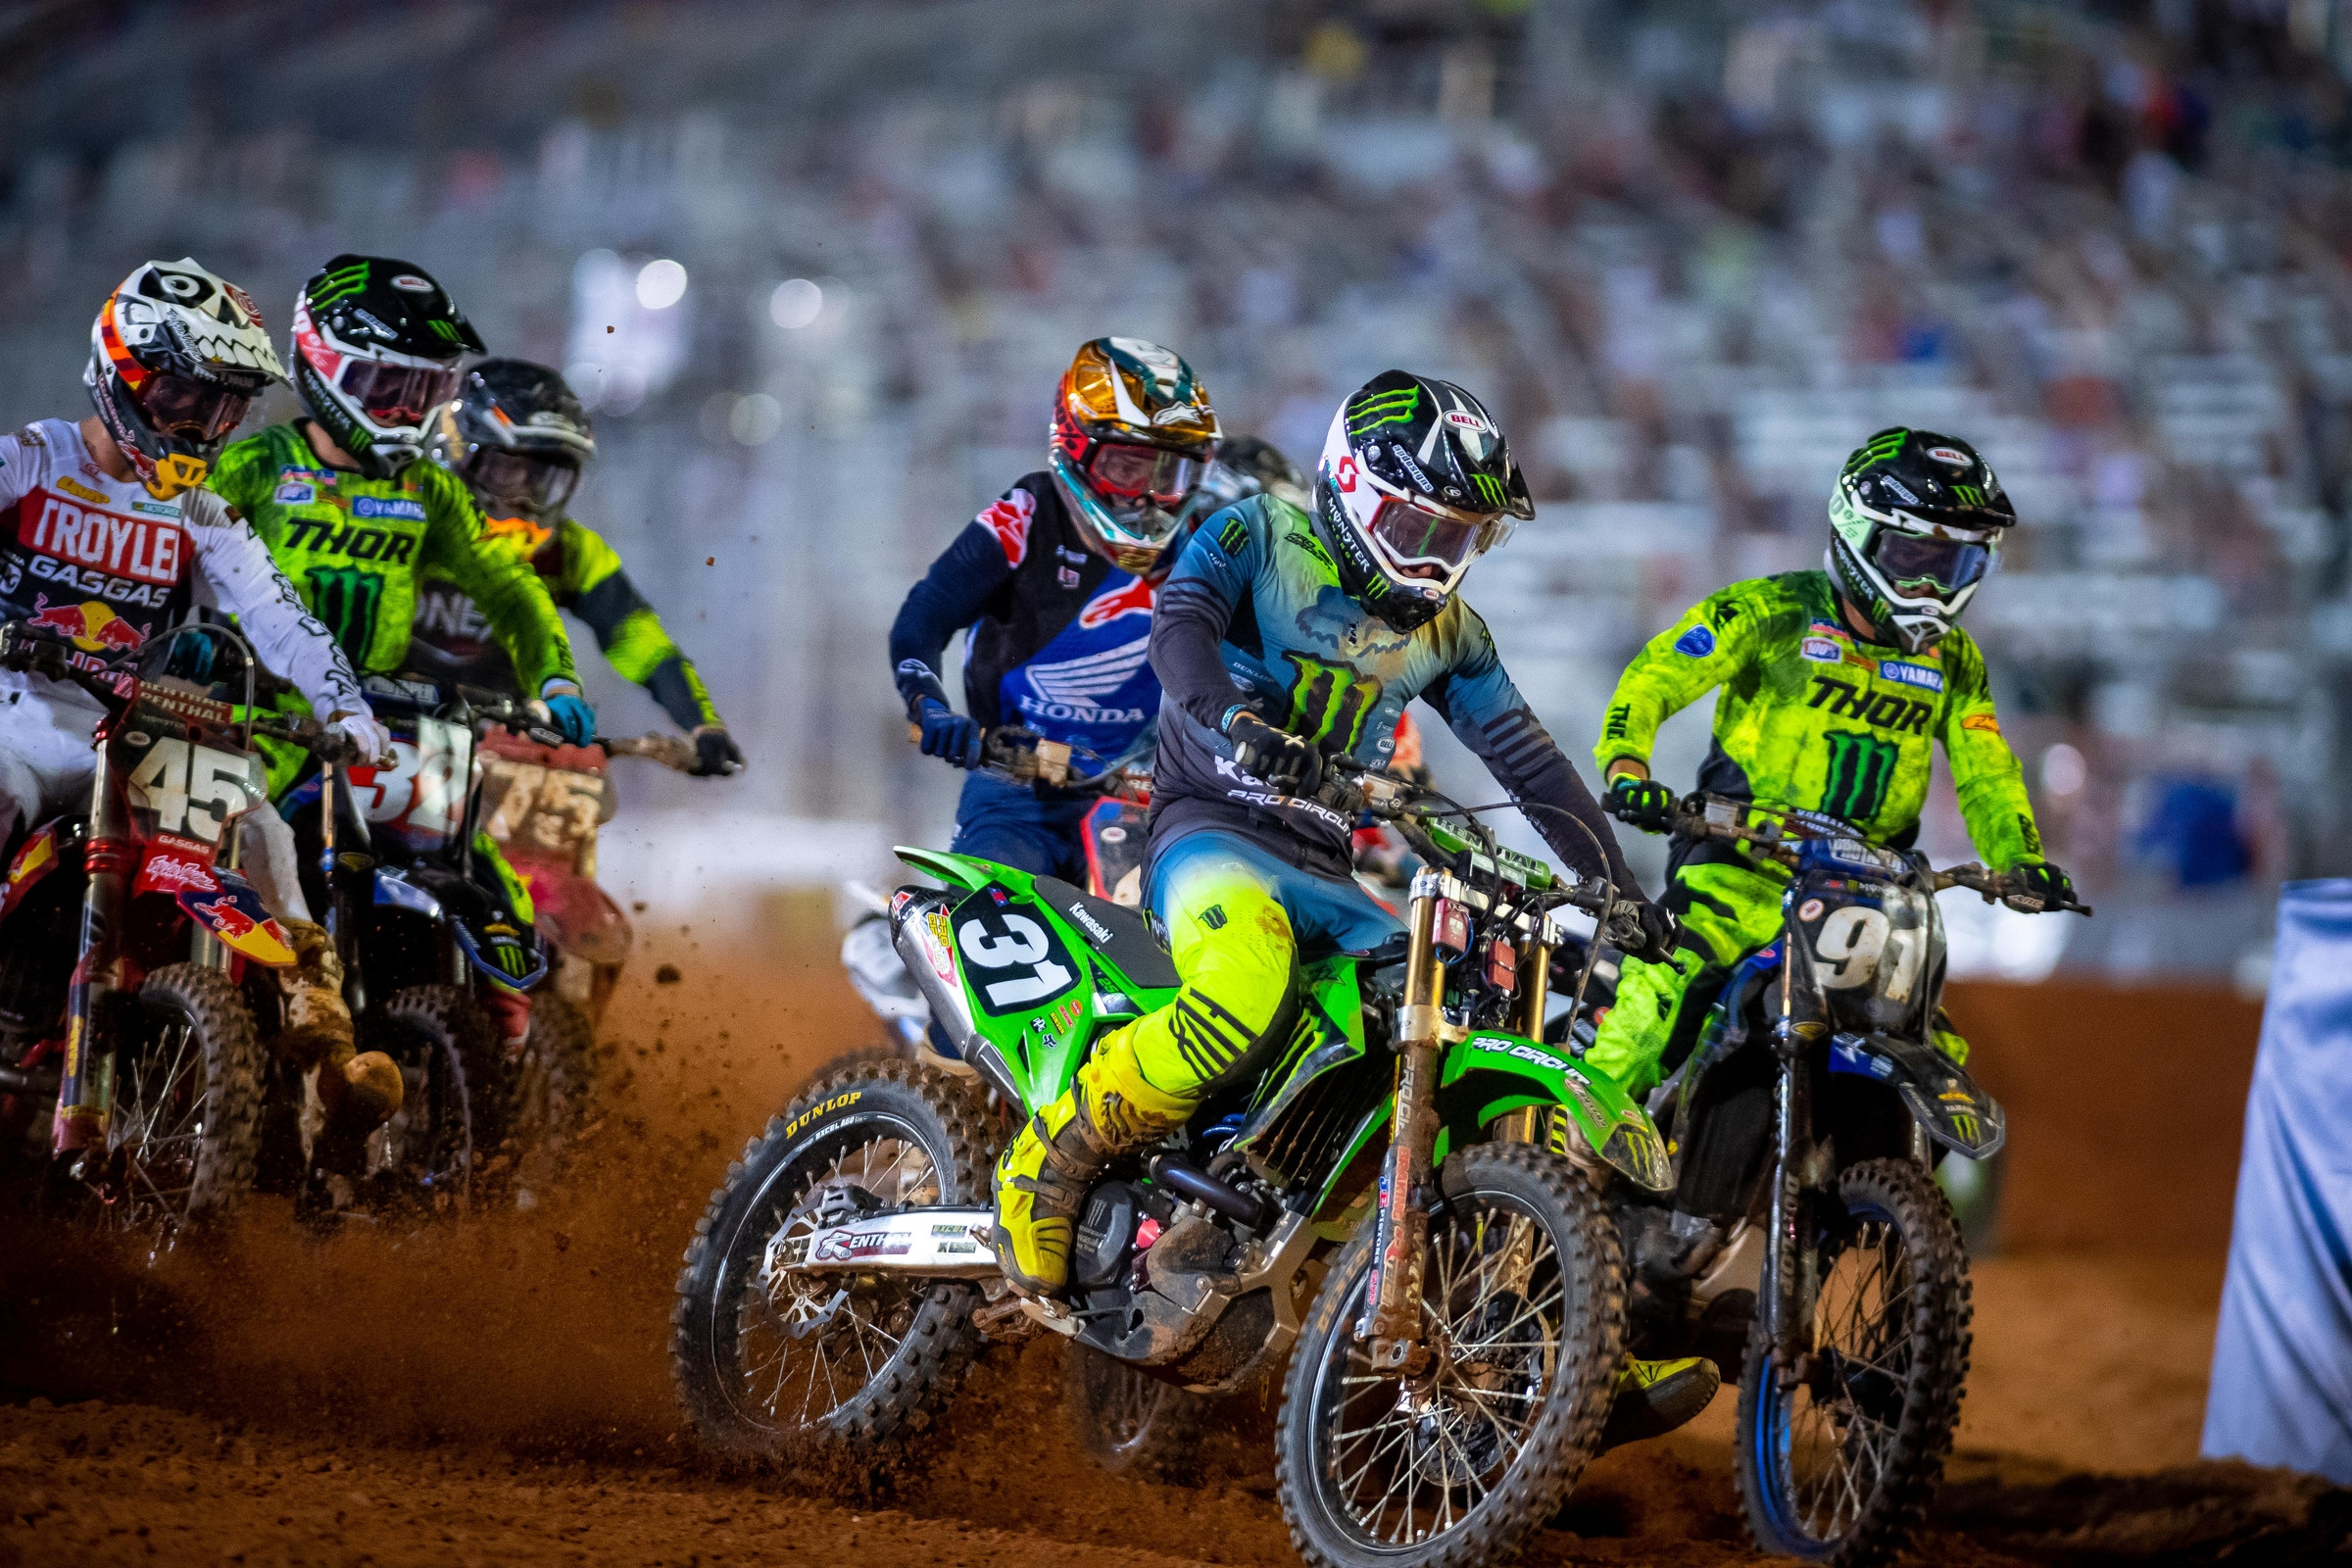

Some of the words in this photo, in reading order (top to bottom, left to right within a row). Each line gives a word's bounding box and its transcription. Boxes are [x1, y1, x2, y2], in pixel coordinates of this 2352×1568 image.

[1449, 414, 1482, 428] BELL
[1392, 444, 1434, 493] apdesigns
[1935, 450, 1967, 463] BELL
[284, 516, 416, 565] THOR
[1327, 497, 1370, 573] MONSTER
[1328, 514, 1357, 567] ENERGY
[28, 554, 172, 609] GASGAS
[1019, 695, 1146, 723] HONDA
[1806, 674, 1934, 736] THOR
[126, 735, 251, 843] 45
[1227, 789, 1287, 806] PRO
[159, 835, 210, 854] GASGAS
[937, 914, 950, 948] PRO
[1068, 902, 1114, 944] Kawasaki
[958, 913, 1072, 1007] 31
[1815, 906, 1929, 1003] 91
[1399, 1054, 1415, 1102] PRO
[1472, 1037, 1510, 1053] PRO
[1509, 1043, 1592, 1086] CIRCUIT
[785, 1091, 862, 1140] DUNLOP
[815, 1122, 840, 1141] EXCEL
[840, 1115, 856, 1128] A60
[1378, 1176, 1391, 1207] JE
[1373, 1208, 1386, 1264] PISTONS
